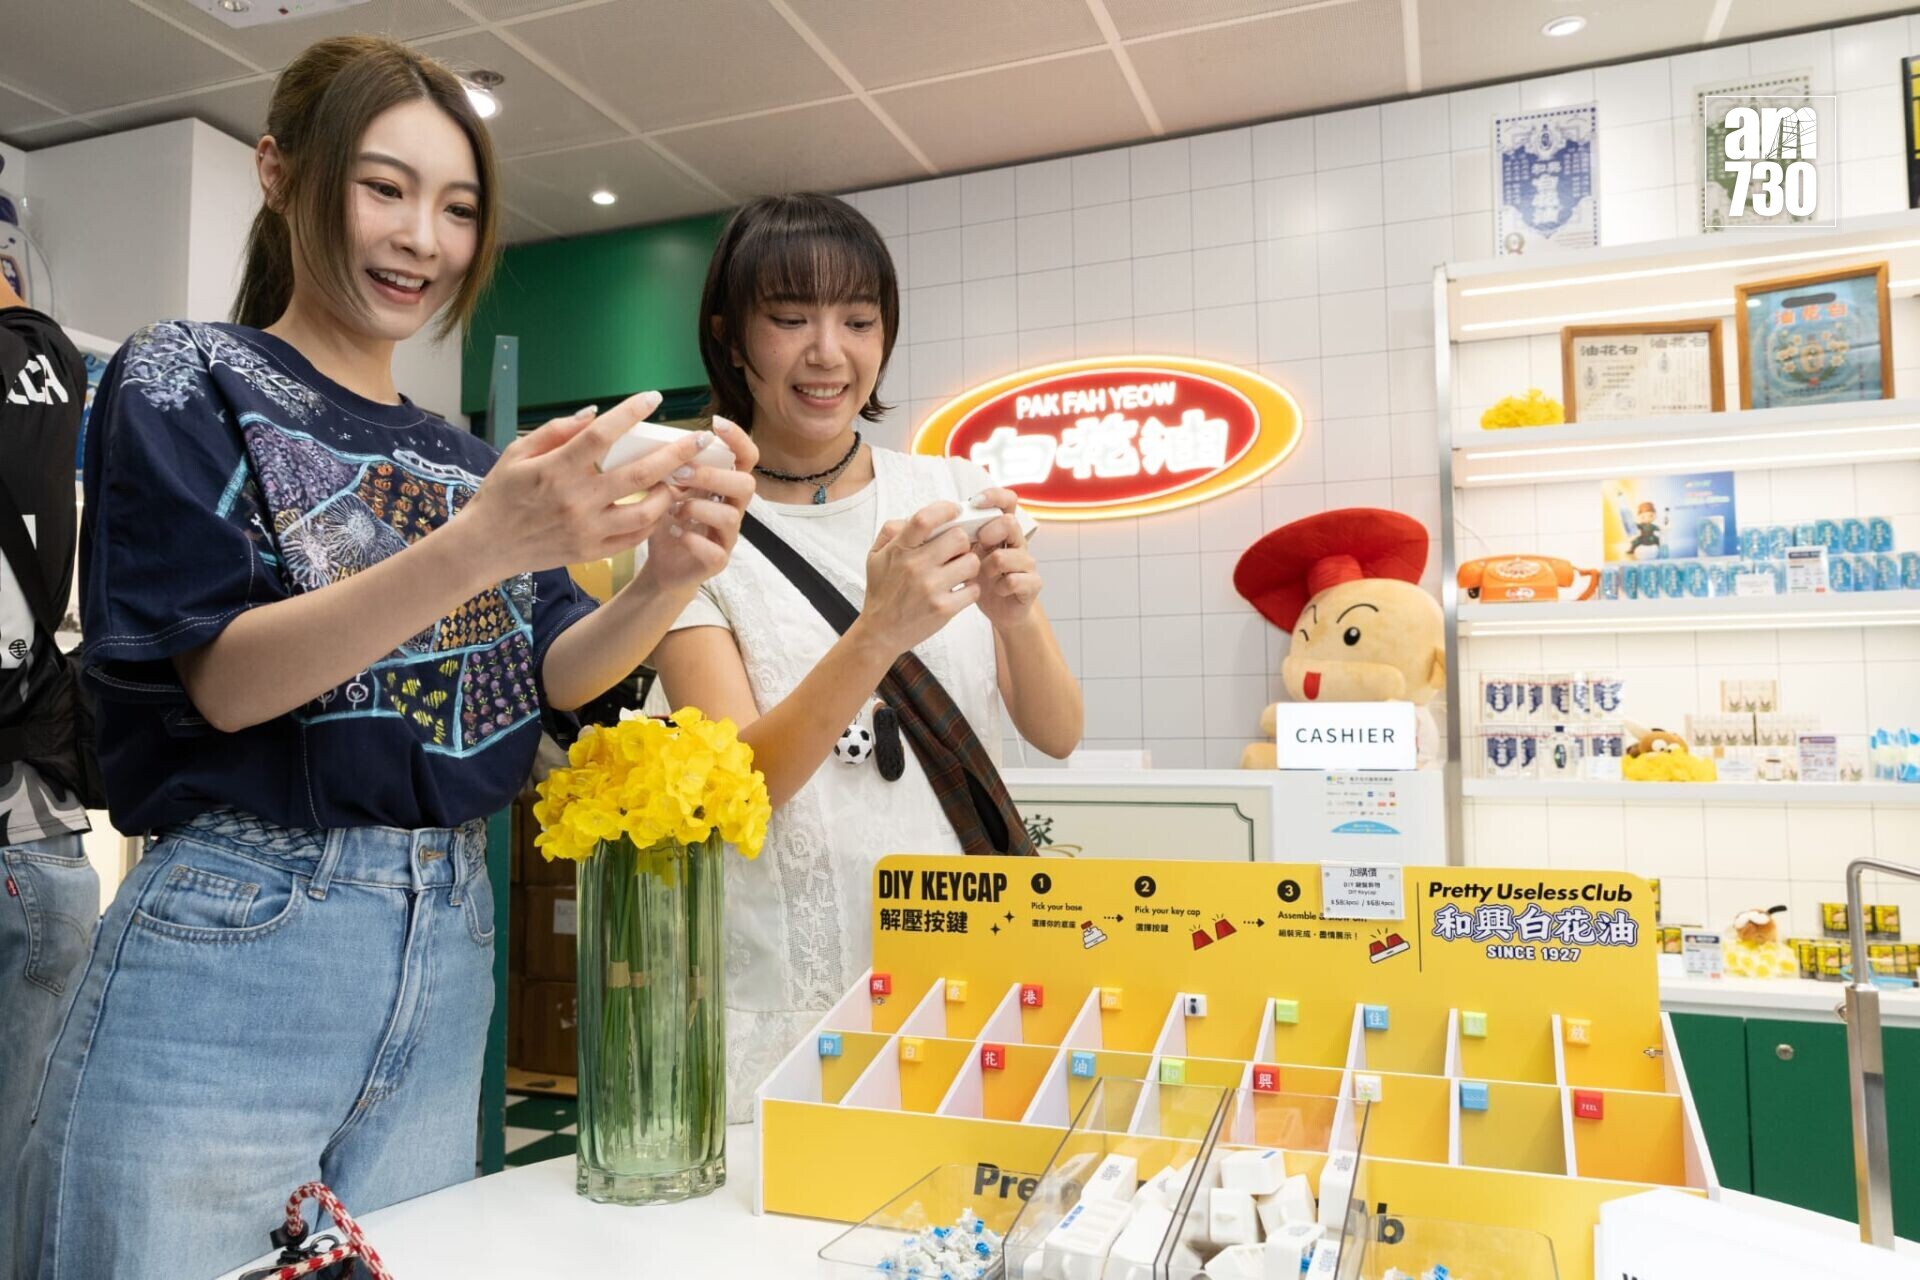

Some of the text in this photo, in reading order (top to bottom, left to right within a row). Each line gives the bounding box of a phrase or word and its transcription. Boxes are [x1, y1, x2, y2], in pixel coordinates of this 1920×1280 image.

[1016, 381, 1177, 419] PAK FAH YEOW
[969, 408, 1229, 485] 白花油
[1295, 727, 1395, 744] CASHIER
[879, 869, 1008, 902] DIY KEYCAP
[1429, 881, 1633, 902] Pretty Useless Club
[1031, 902, 1083, 912] Pick your base
[1134, 905, 1201, 917] Pick your key cap
[1278, 911, 1317, 920] Assemble
[879, 907, 969, 934] 解壓按鍵
[1433, 902, 1640, 946] 和興白花油
[1486, 944, 1581, 963] SINCE 1927
[1023, 989, 1038, 1005] 港
[984, 1051, 998, 1067] 花
[1073, 1058, 1089, 1075] 油
[1258, 1073, 1273, 1089] 興
